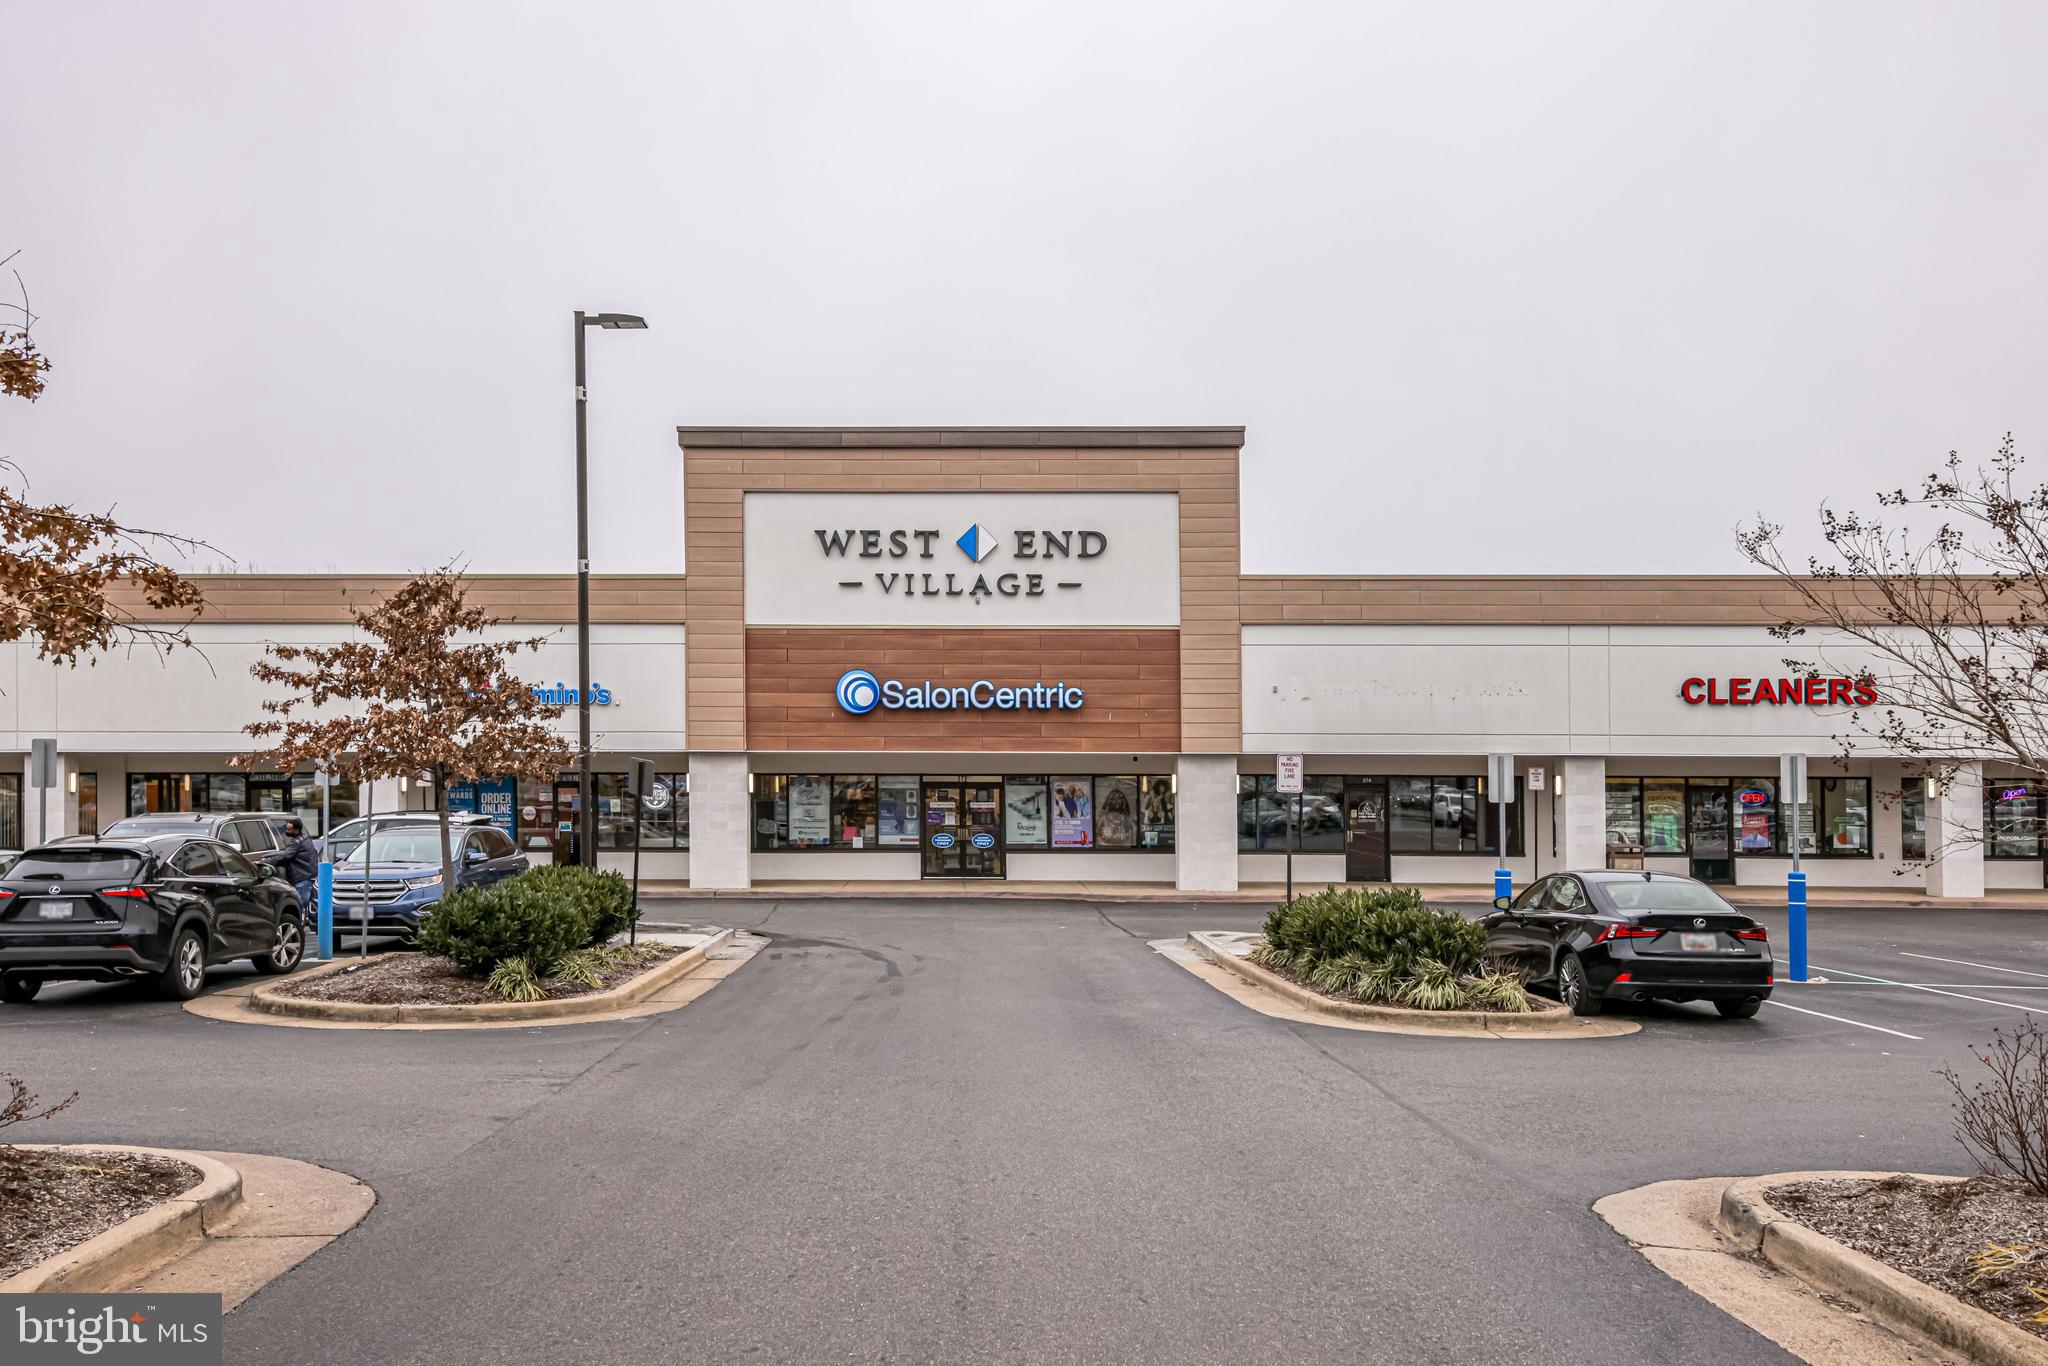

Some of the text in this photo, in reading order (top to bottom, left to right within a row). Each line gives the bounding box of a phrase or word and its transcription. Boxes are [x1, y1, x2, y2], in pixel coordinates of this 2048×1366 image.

[814, 529, 1108, 559] WEST END
[875, 573, 1045, 596] VILLAGE
[881, 679, 1084, 710] SalonCentric
[1681, 676, 1878, 706] CLEANERS
[481, 792, 512, 804] ORDER
[481, 803, 512, 814] ONLINE
[1740, 792, 1766, 802] OPEN
